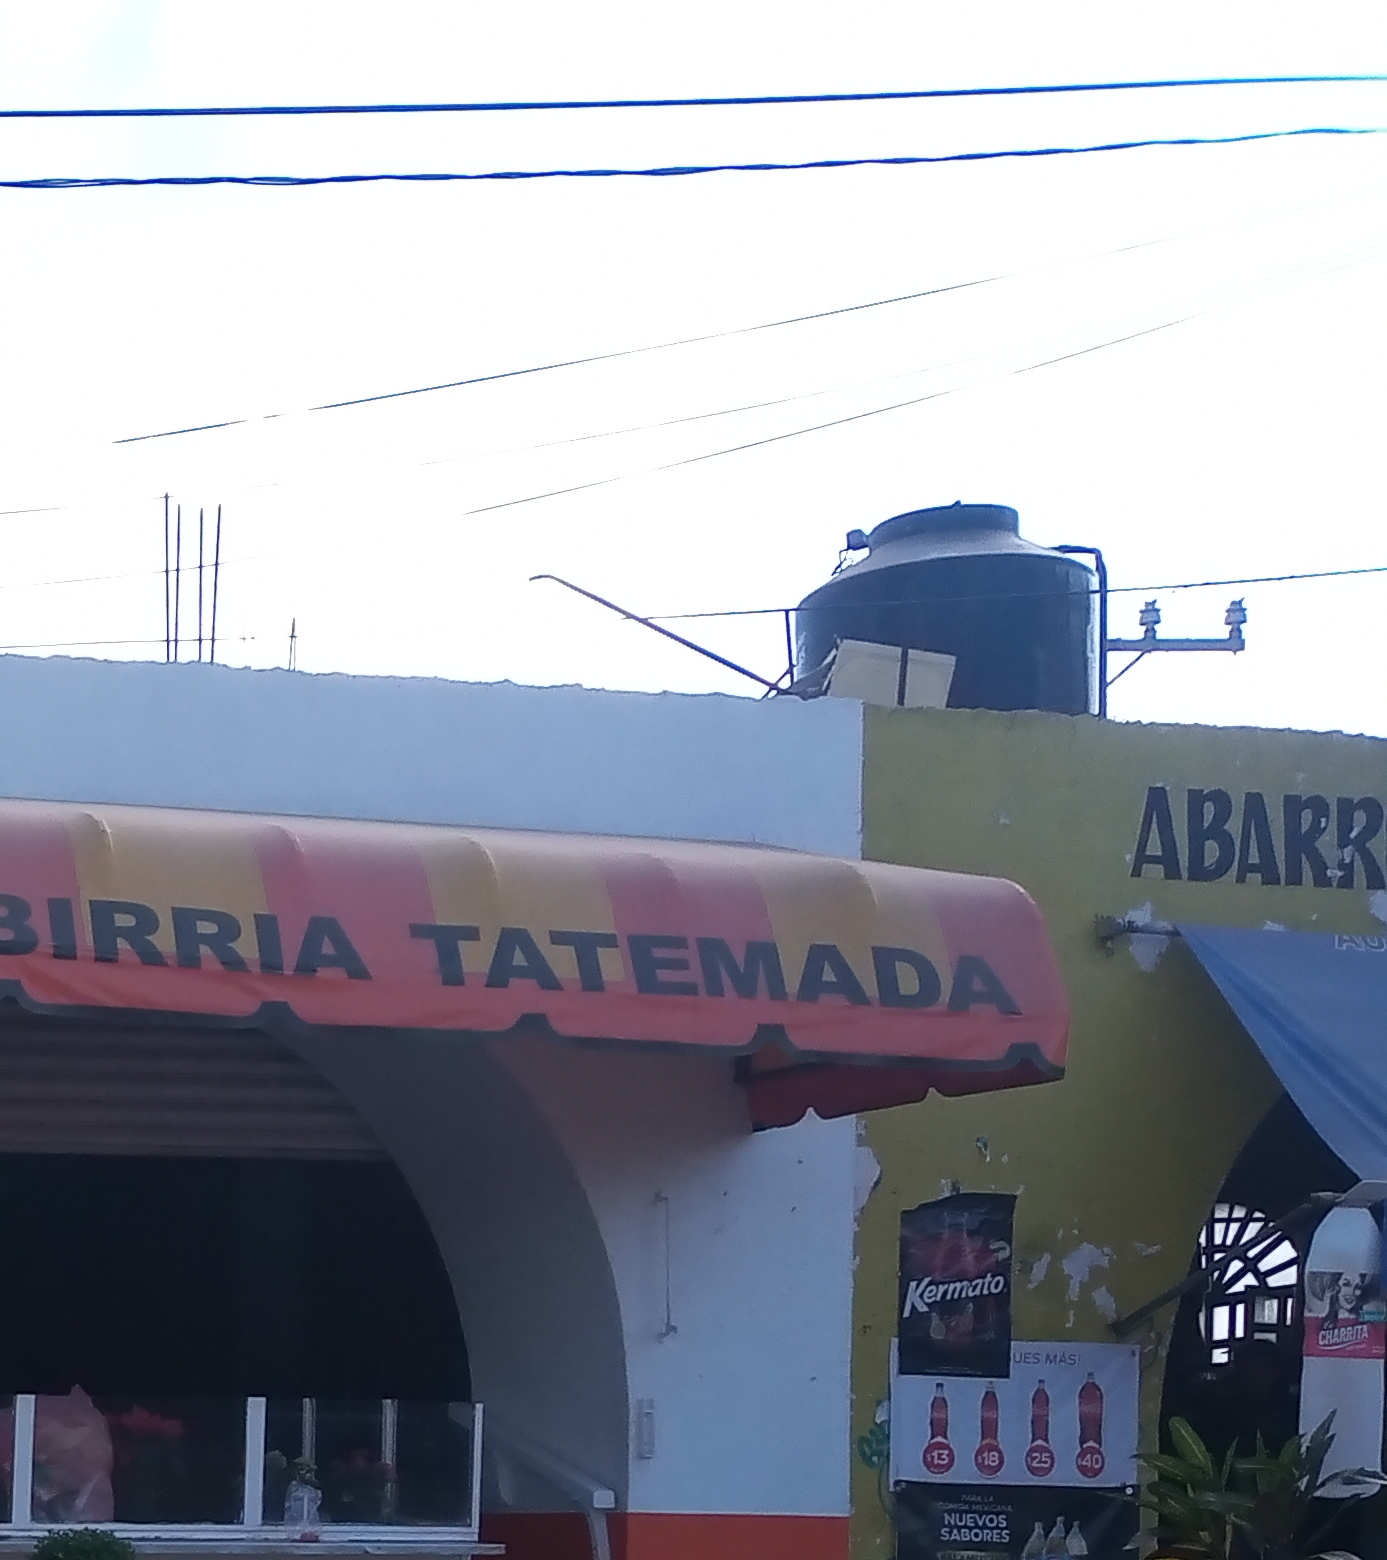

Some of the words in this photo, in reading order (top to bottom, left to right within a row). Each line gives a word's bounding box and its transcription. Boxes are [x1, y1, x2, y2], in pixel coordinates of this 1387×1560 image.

[1130, 786, 1387, 890] ABARR
[409, 923, 1025, 1018] TATEMADA
[902, 1273, 1005, 1319] Kermato
[1318, 1324, 1369, 1346] CHARRITA
[1012, 1351, 1041, 1366] UES
[943, 1512, 1007, 1528] NUEVOS
[939, 1527, 1011, 1543] SABORES
